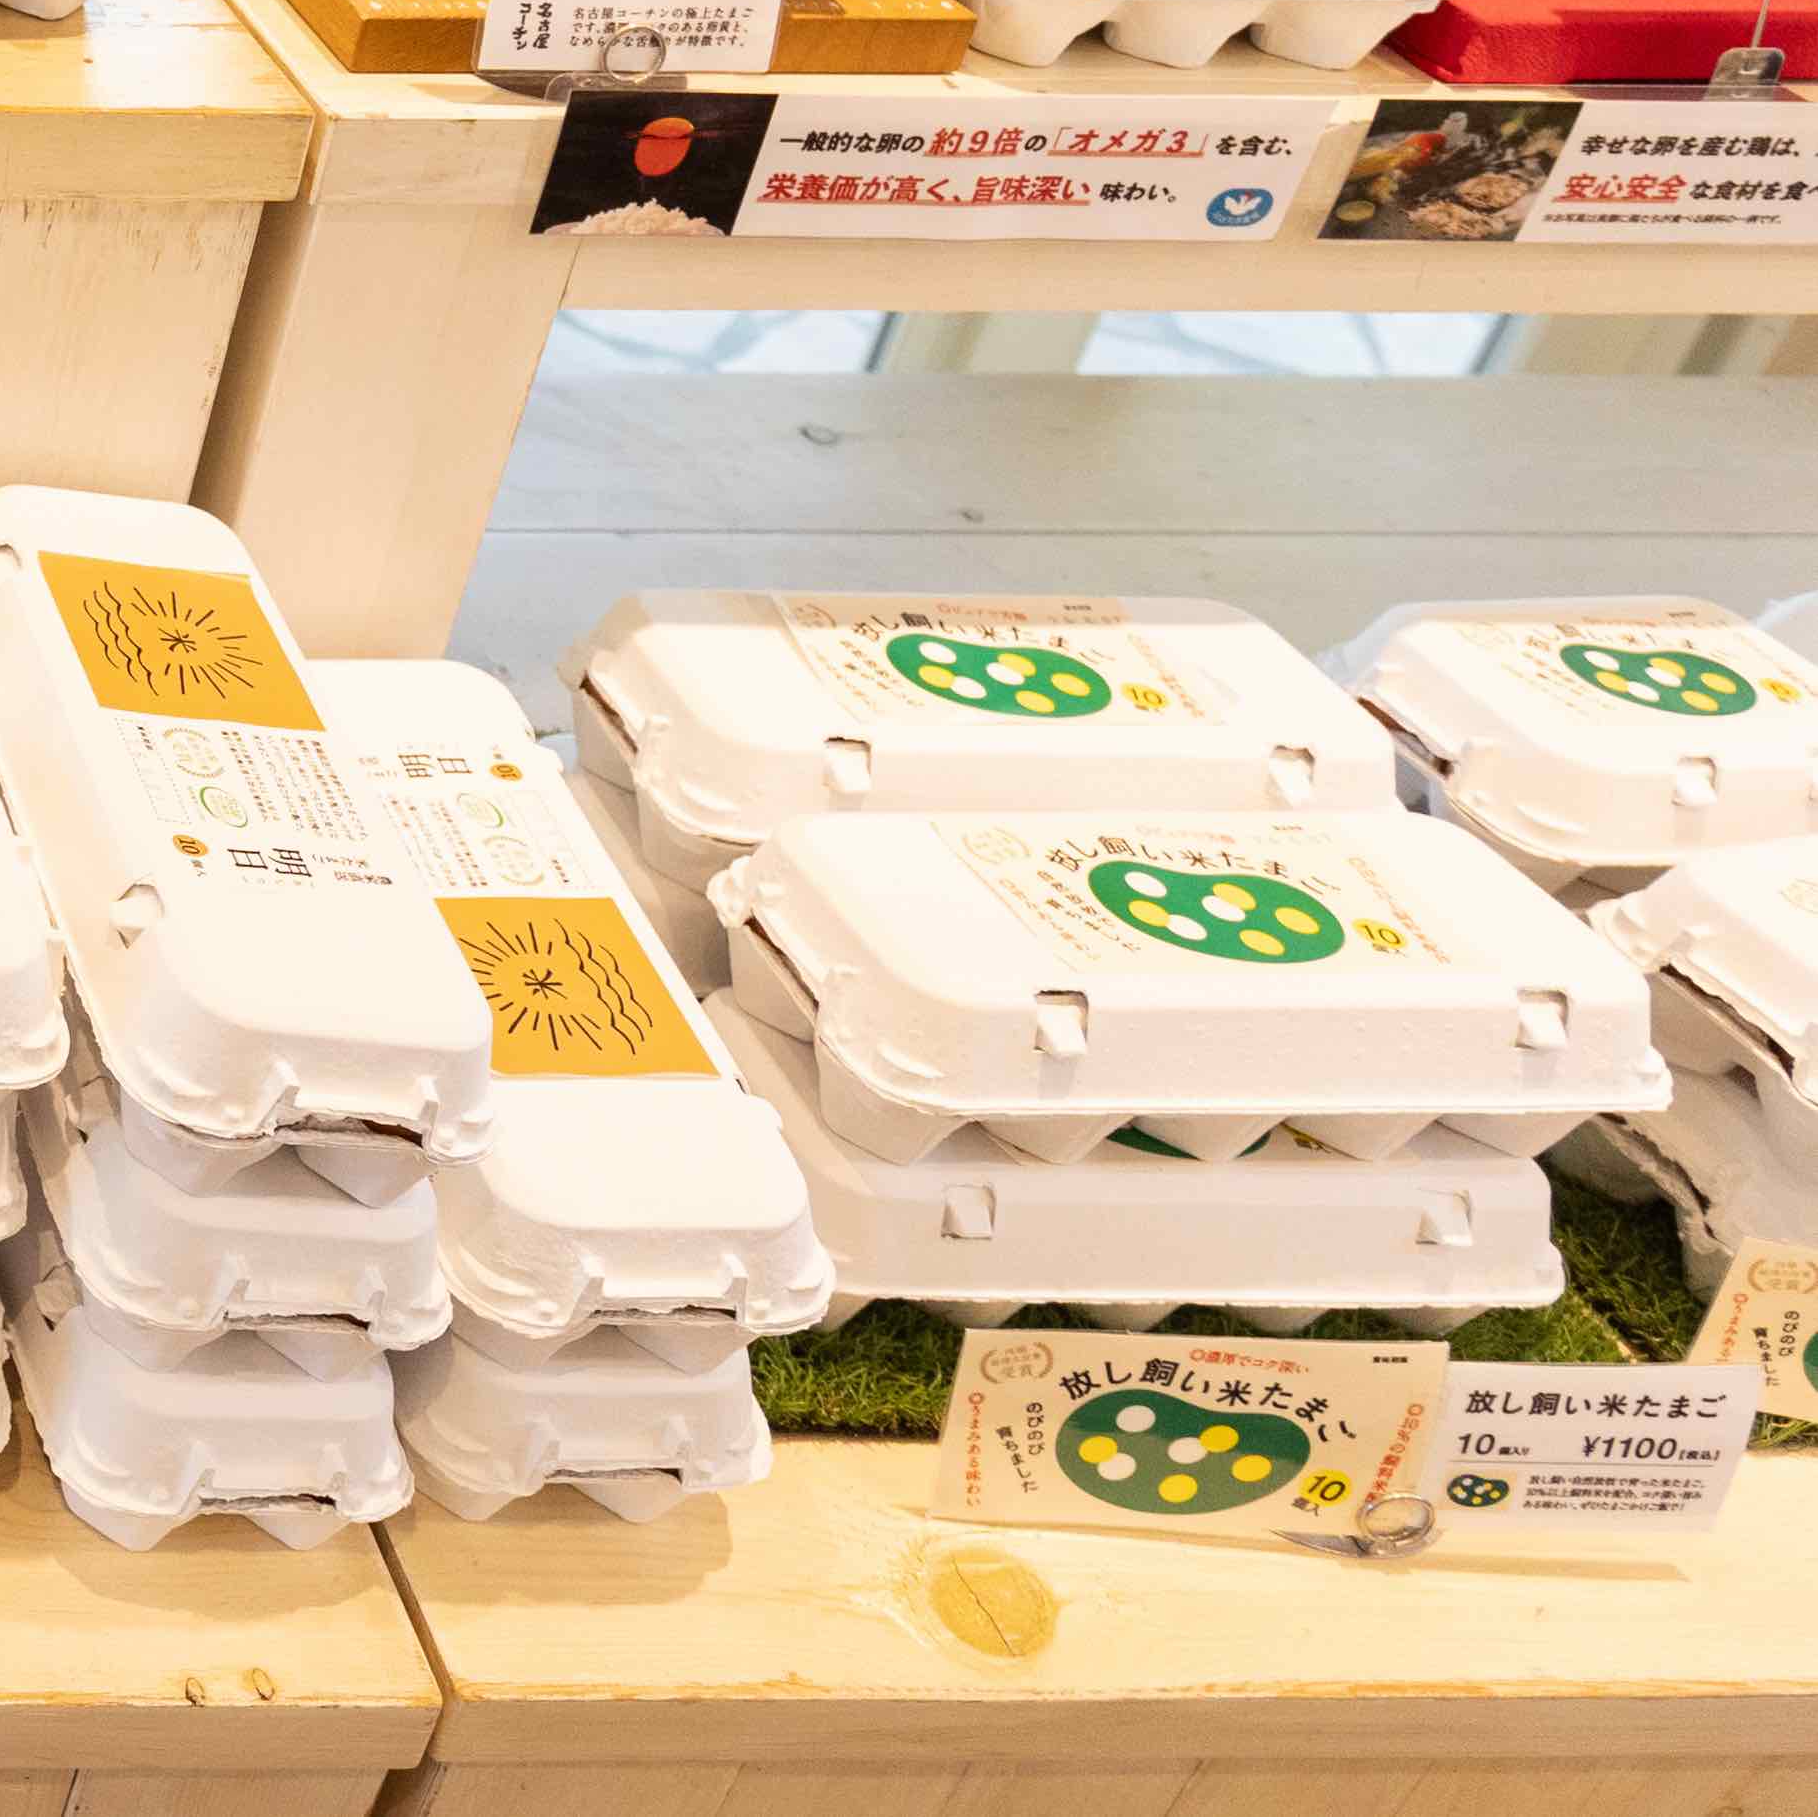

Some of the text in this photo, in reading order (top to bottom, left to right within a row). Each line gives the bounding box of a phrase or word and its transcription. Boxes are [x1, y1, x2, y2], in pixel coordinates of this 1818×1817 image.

[511, 1, 533, 51] コーチン
[533, 1, 554, 50] 名古屋
[1581, 134, 1801, 158] 幸せな卵を産む鶏は、
[762, 172, 1180, 204] 栄養価が高く、旨味深い味わい。
[226, 847, 313, 879] 明日
[1362, 922, 1402, 947] 10
[1059, 1357, 1360, 1445] 放し飼い米たまご
[1464, 1389, 1728, 1420] 放し飼い米たまご
[1025, 1401, 1045, 1457] のびのび
[995, 1425, 1040, 1494] 育ちました
[1456, 1432, 1678, 1461] 10 ¥1100
[1306, 1475, 1347, 1503] 10
